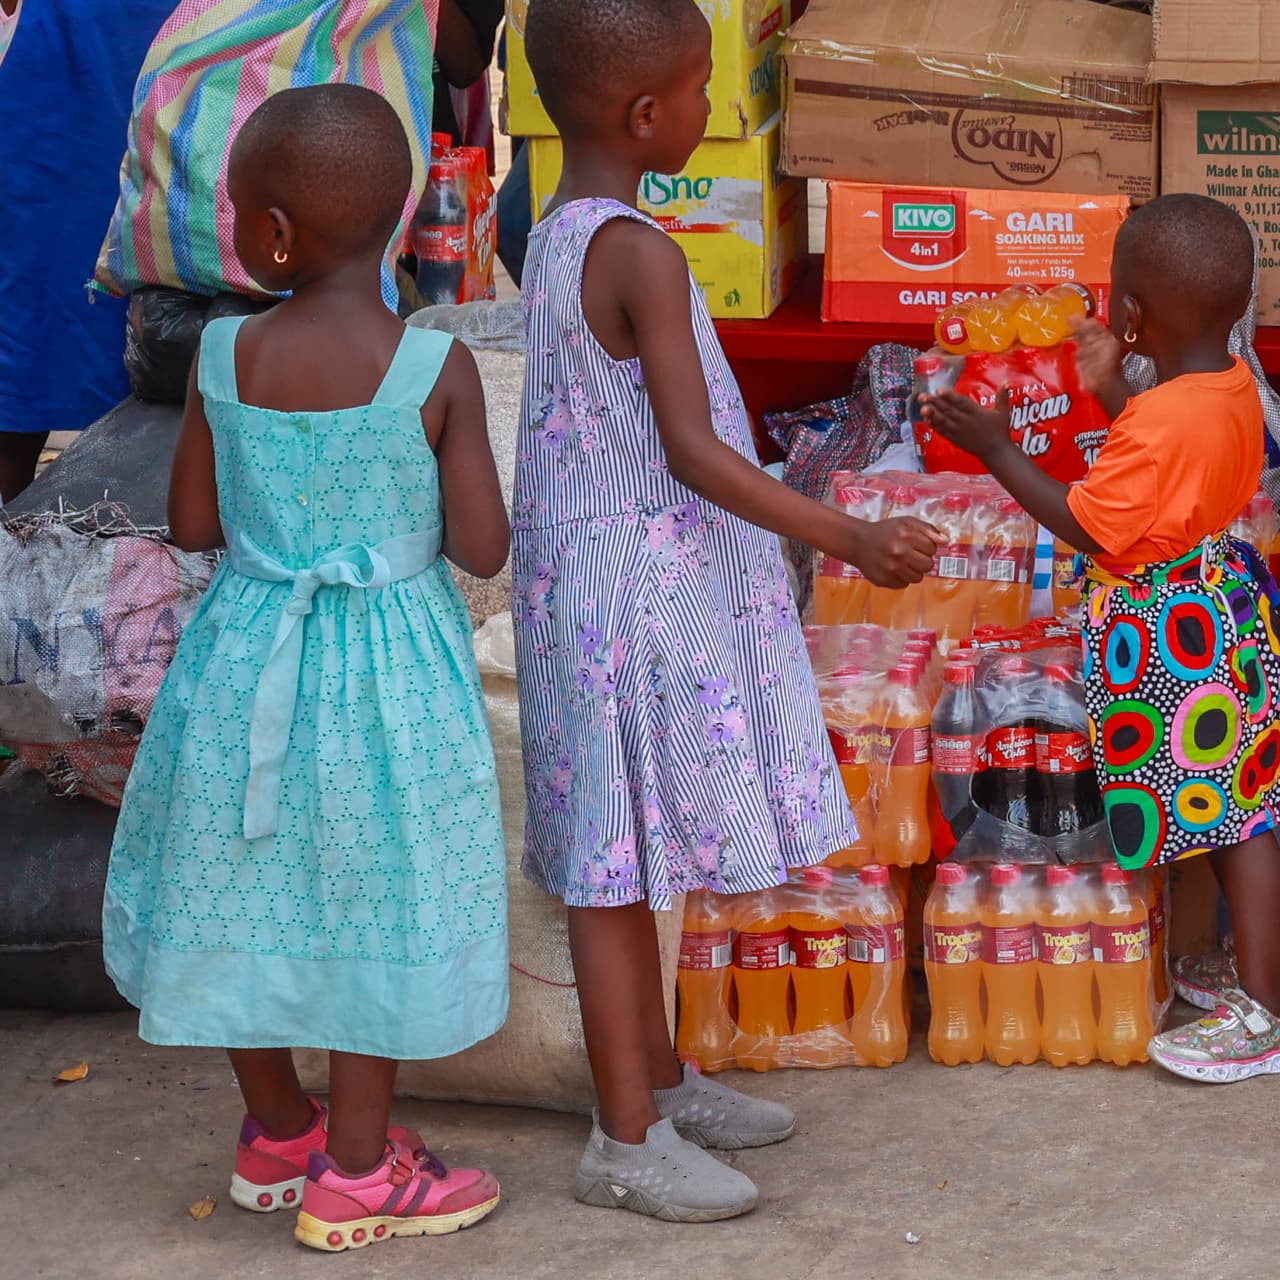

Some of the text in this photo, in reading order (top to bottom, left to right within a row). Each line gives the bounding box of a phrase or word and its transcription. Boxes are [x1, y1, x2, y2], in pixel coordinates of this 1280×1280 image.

[967, 126, 1057, 160] NIDO
[1206, 164, 1239, 178] Made
[1241, 164, 1253, 178] in
[1206, 183, 1248, 197] Wilmar
[897, 208, 953, 228] KIVO
[1006, 211, 1074, 232] GARI
[995, 233, 1085, 245] SOAKING MIX
[910, 242, 940, 257] 4in1
[1049, 266, 1076, 281] 125g
[898, 289, 946, 305] GARI
[996, 738, 1035, 753] American
[1003, 747, 1027, 760] Cola
